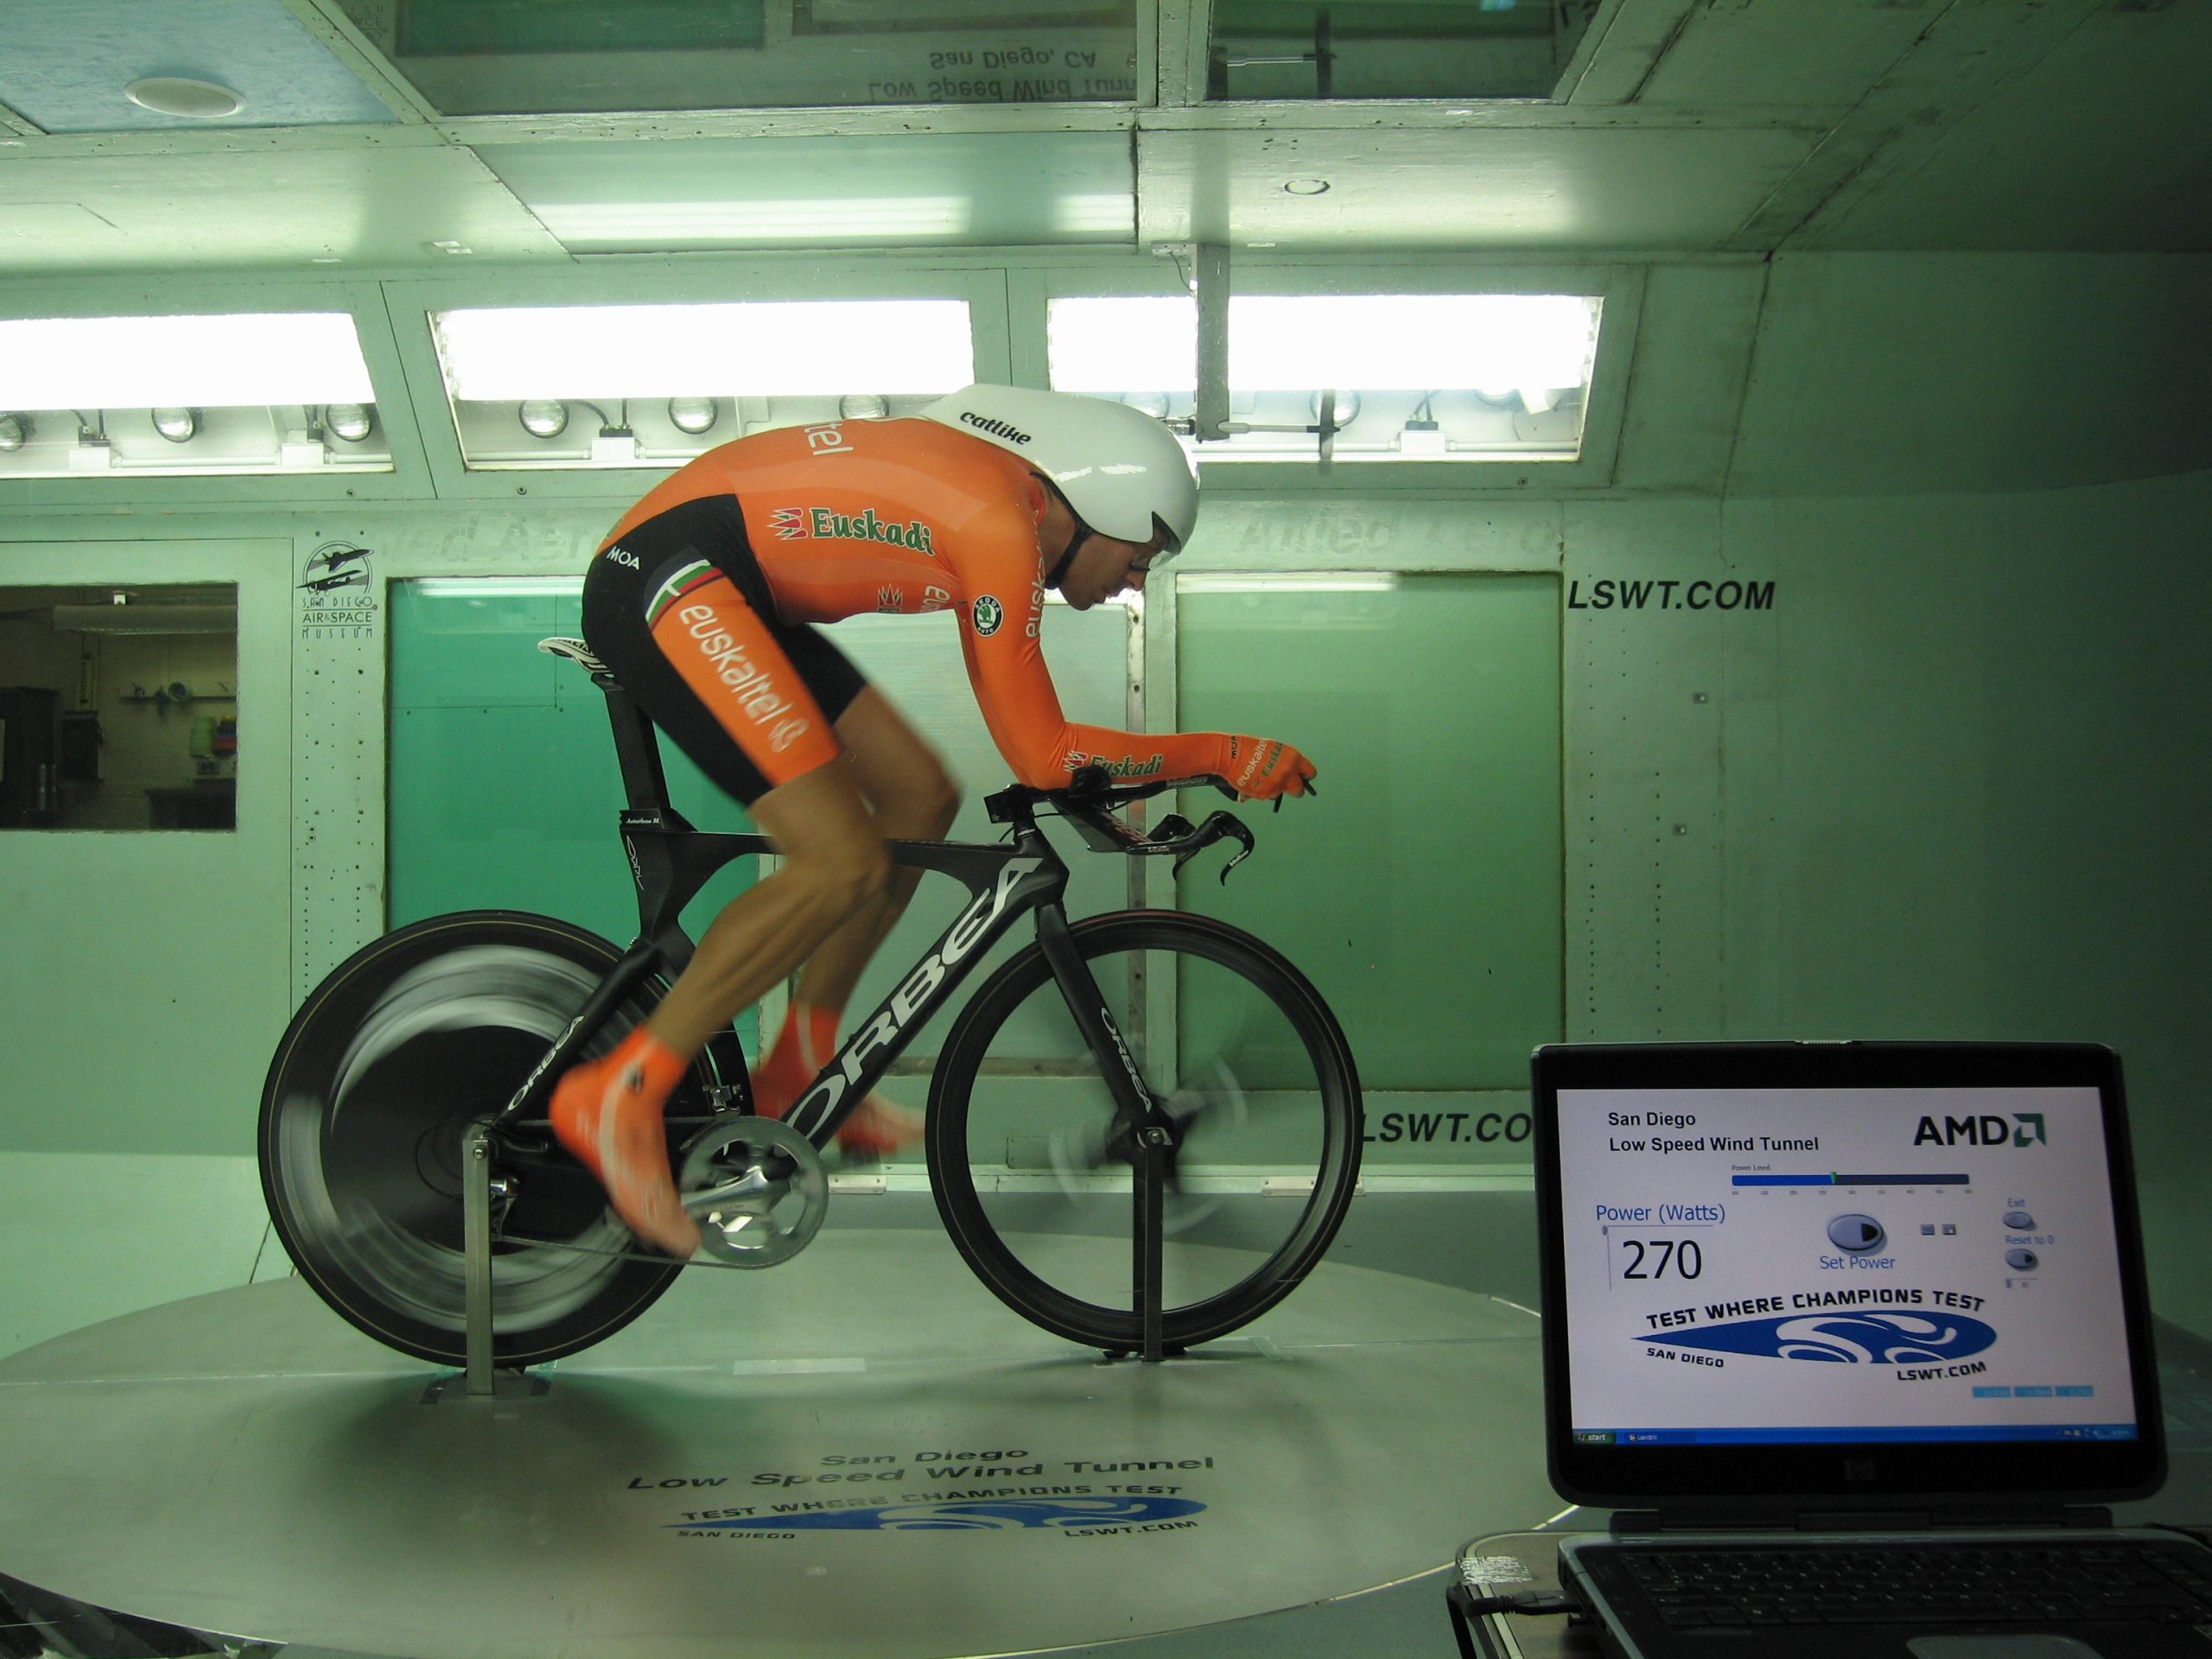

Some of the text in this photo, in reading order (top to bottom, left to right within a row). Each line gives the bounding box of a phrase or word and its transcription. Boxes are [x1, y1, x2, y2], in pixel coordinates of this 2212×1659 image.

[960, 411, 1032, 446] catlike
[809, 507, 937, 557] Euskadi
[606, 545, 641, 571] MOA
[302, 596, 373, 608] SAN DIEGO
[1567, 580, 1776, 610] LSWT.COM
[302, 627, 373, 639] MUSEUM
[679, 604, 794, 727] euskaltel
[786, 857, 1044, 1141] ORBEA
[507, 1015, 585, 1111] ORBEA
[1100, 1007, 1151, 1113] ORBEA
[1363, 1113, 1532, 1143] LSWT.CO
[1608, 1111, 1696, 1129] San Diego
[1913, 1116, 2009, 1147] AMD
[1609, 1136, 1820, 1155] Low Speed Wind Tunnel
[1596, 1204, 1726, 1224] Power (Watts)
[1623, 1240, 1702, 1280] 270
[1820, 1255, 1896, 1269] Set Power
[1646, 1288, 1986, 1329] TEST WHERE CHAMPIONS TEST
[1646, 1347, 1725, 1368] SAN DIEGO
[1897, 1361, 1987, 1382] LSWT.COM
[820, 1449, 1029, 1466] San Diego
[626, 1456, 1215, 1491] Low Speed Wind Tunnel
[682, 1484, 1184, 1522] TEST WHERE CHAMPIONS TEST
[730, 1531, 797, 1541] DIEGO
[1064, 1520, 1200, 1538] LSWT.COM
